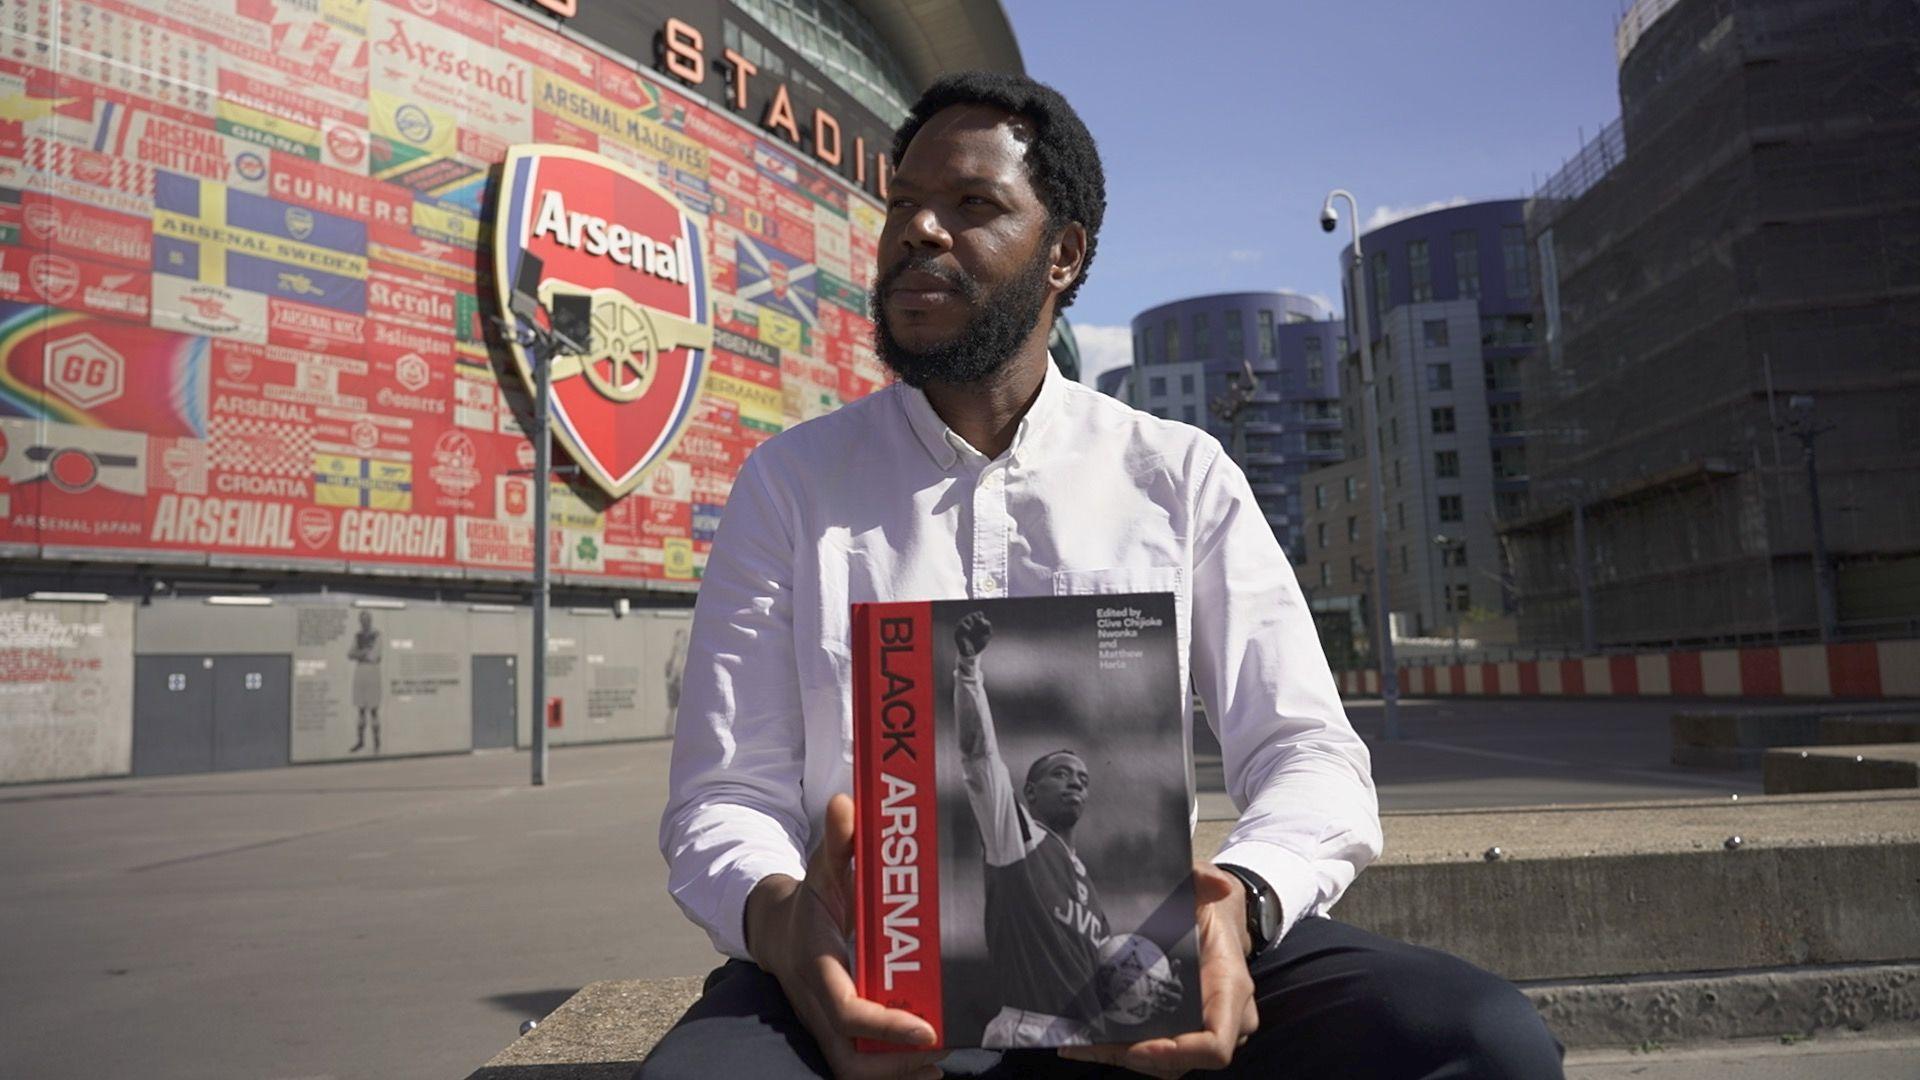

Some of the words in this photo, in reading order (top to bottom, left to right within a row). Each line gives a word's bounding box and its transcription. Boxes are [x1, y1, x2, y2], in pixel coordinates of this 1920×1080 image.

[224, 90, 320, 129] ARSENAL
[543, 81, 621, 134] ARSENAL
[625, 117, 705, 169] MALDIVES
[145, 118, 227, 156] ARSENAL
[231, 125, 307, 157] GHANA
[138, 139, 230, 182] BRITTANY
[273, 172, 410, 226] GUNNERS
[161, 218, 267, 251] ARSENAL
[278, 243, 362, 273] SWEDEN
[534, 189, 688, 284] Arsenal
[370, 282, 453, 321] Kerala
[62, 355, 107, 387] GG
[213, 395, 312, 423] ARSENAL
[216, 473, 309, 498] CROATIA
[13, 513, 92, 534] ARSENAL
[95, 519, 142, 536] JAPAN
[151, 495, 296, 549] ARSENAL
[338, 509, 448, 558] GEORGIA
[1096, 607, 1128, 618] Edited
[1129, 607, 1142, 619] by
[1097, 618, 1122, 628] Clive
[1124, 617, 1163, 629] Chijioke
[1098, 629, 1138, 639] Nwonka
[1099, 639, 1117, 649] and
[1099, 649, 1143, 659] Matthew
[879, 616, 917, 763] BLACK
[881, 772, 921, 991] ARSENAL
[1054, 898, 1111, 949] JVC
